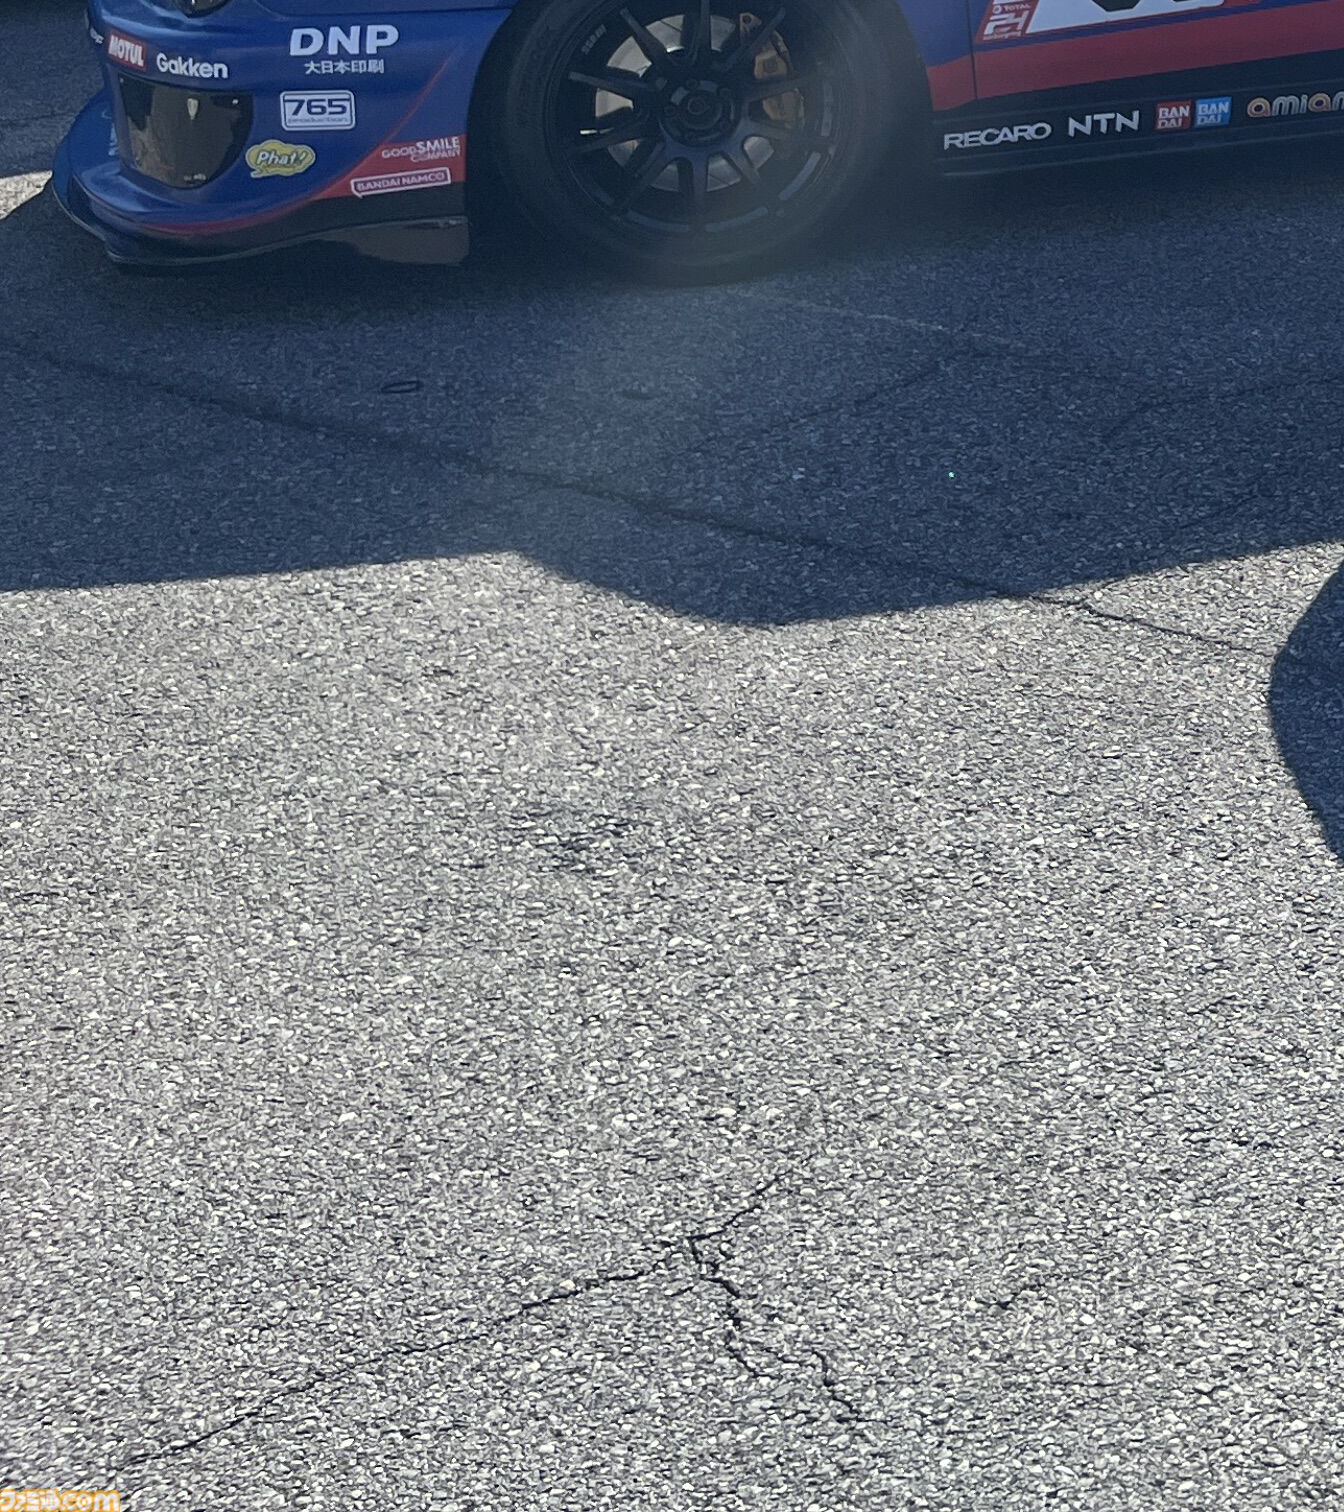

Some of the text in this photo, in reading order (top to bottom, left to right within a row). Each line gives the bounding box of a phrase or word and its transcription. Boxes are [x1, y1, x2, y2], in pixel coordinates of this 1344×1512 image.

[290, 25, 399, 56] DNP
[108, 35, 145, 67] MOTUL
[156, 52, 228, 79] Gakken
[305, 60, 384, 75] 大日本印刷
[285, 98, 350, 116] 765
[944, 121, 1052, 150] RECARO
[1068, 110, 1140, 138] NTN
[416, 136, 460, 153] SMILE
[402, 172, 445, 186] NAMCO
